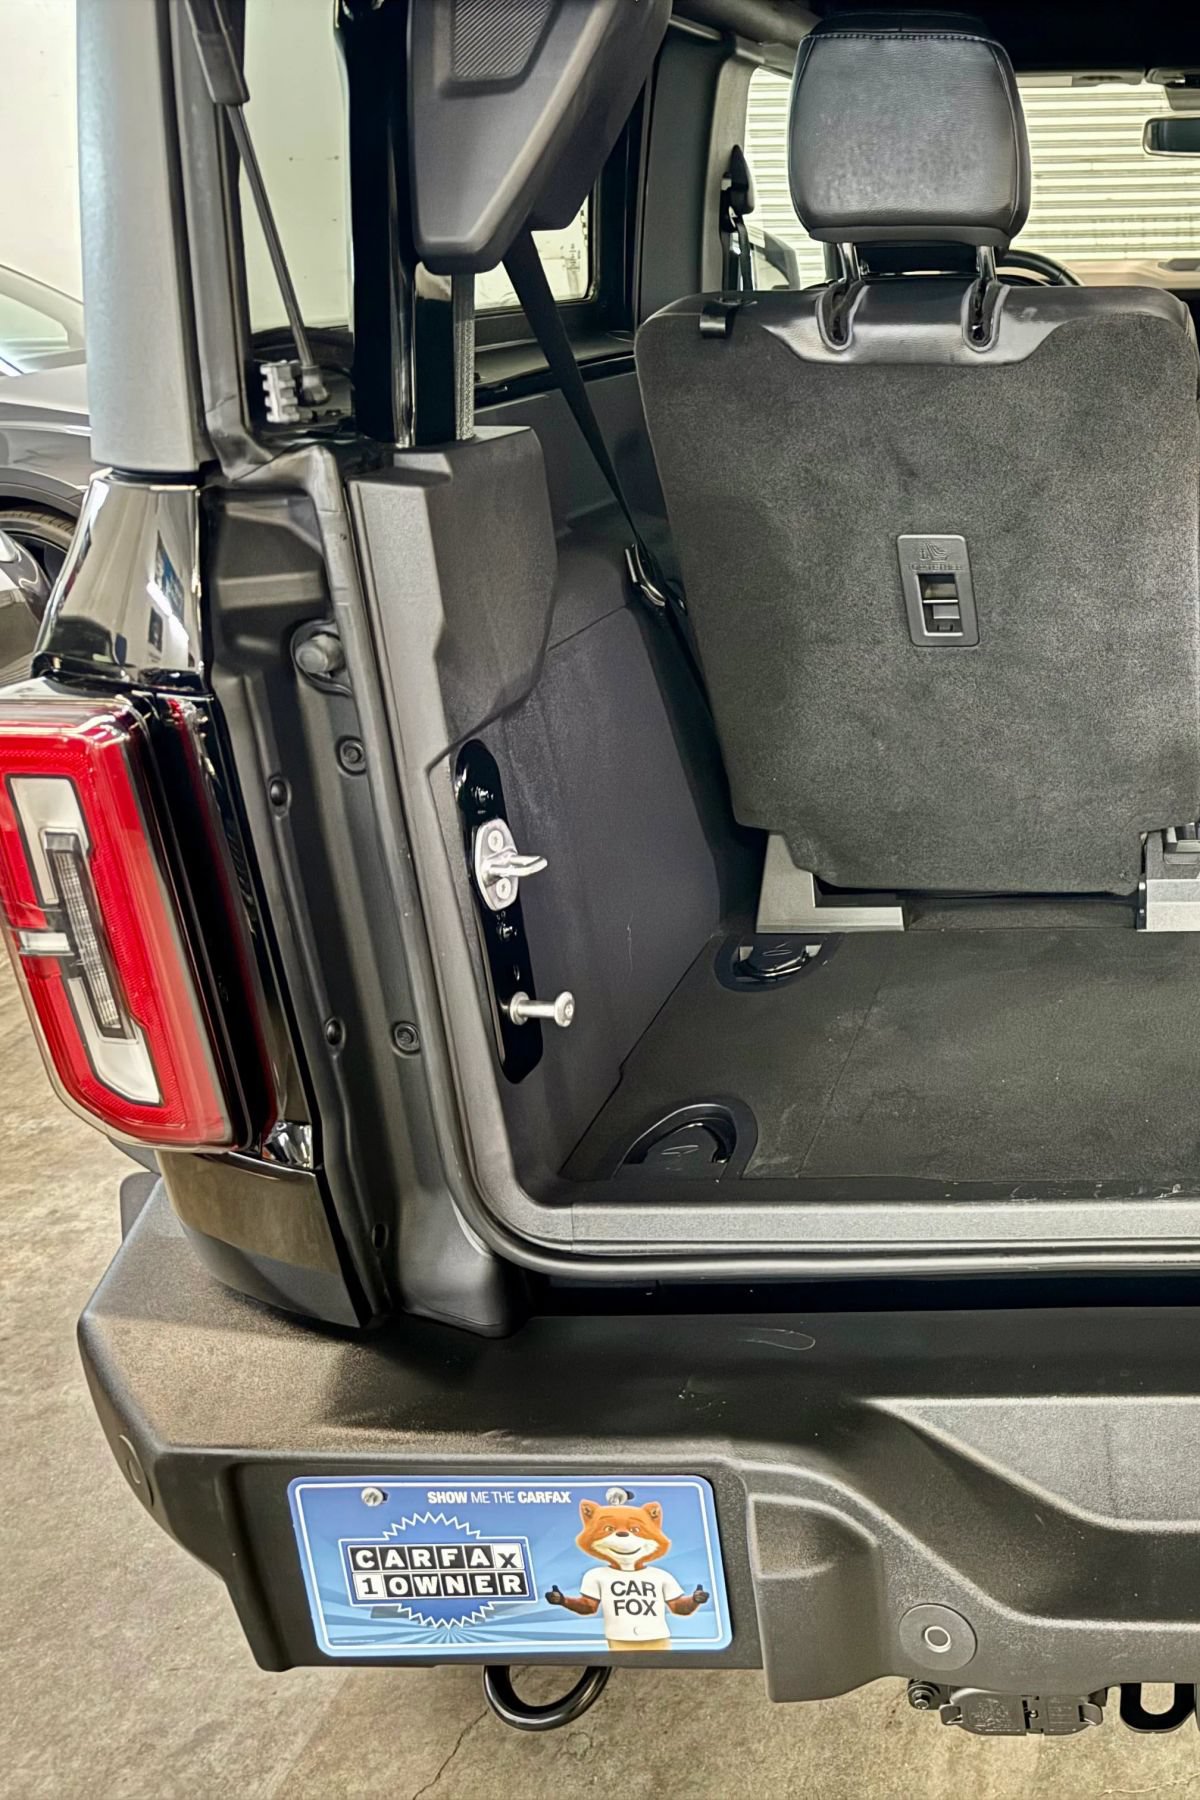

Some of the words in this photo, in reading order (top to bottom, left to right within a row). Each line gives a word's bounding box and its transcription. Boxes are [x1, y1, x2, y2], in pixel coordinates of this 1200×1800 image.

[427, 1491, 468, 1504] SHOW
[470, 1491, 491, 1504] ME
[491, 1491, 516, 1504] THE
[517, 1491, 572, 1504] CARFAX
[355, 1548, 516, 1569] CARFAX
[610, 1580, 657, 1598] CAR
[613, 1599, 657, 1616] FOX
